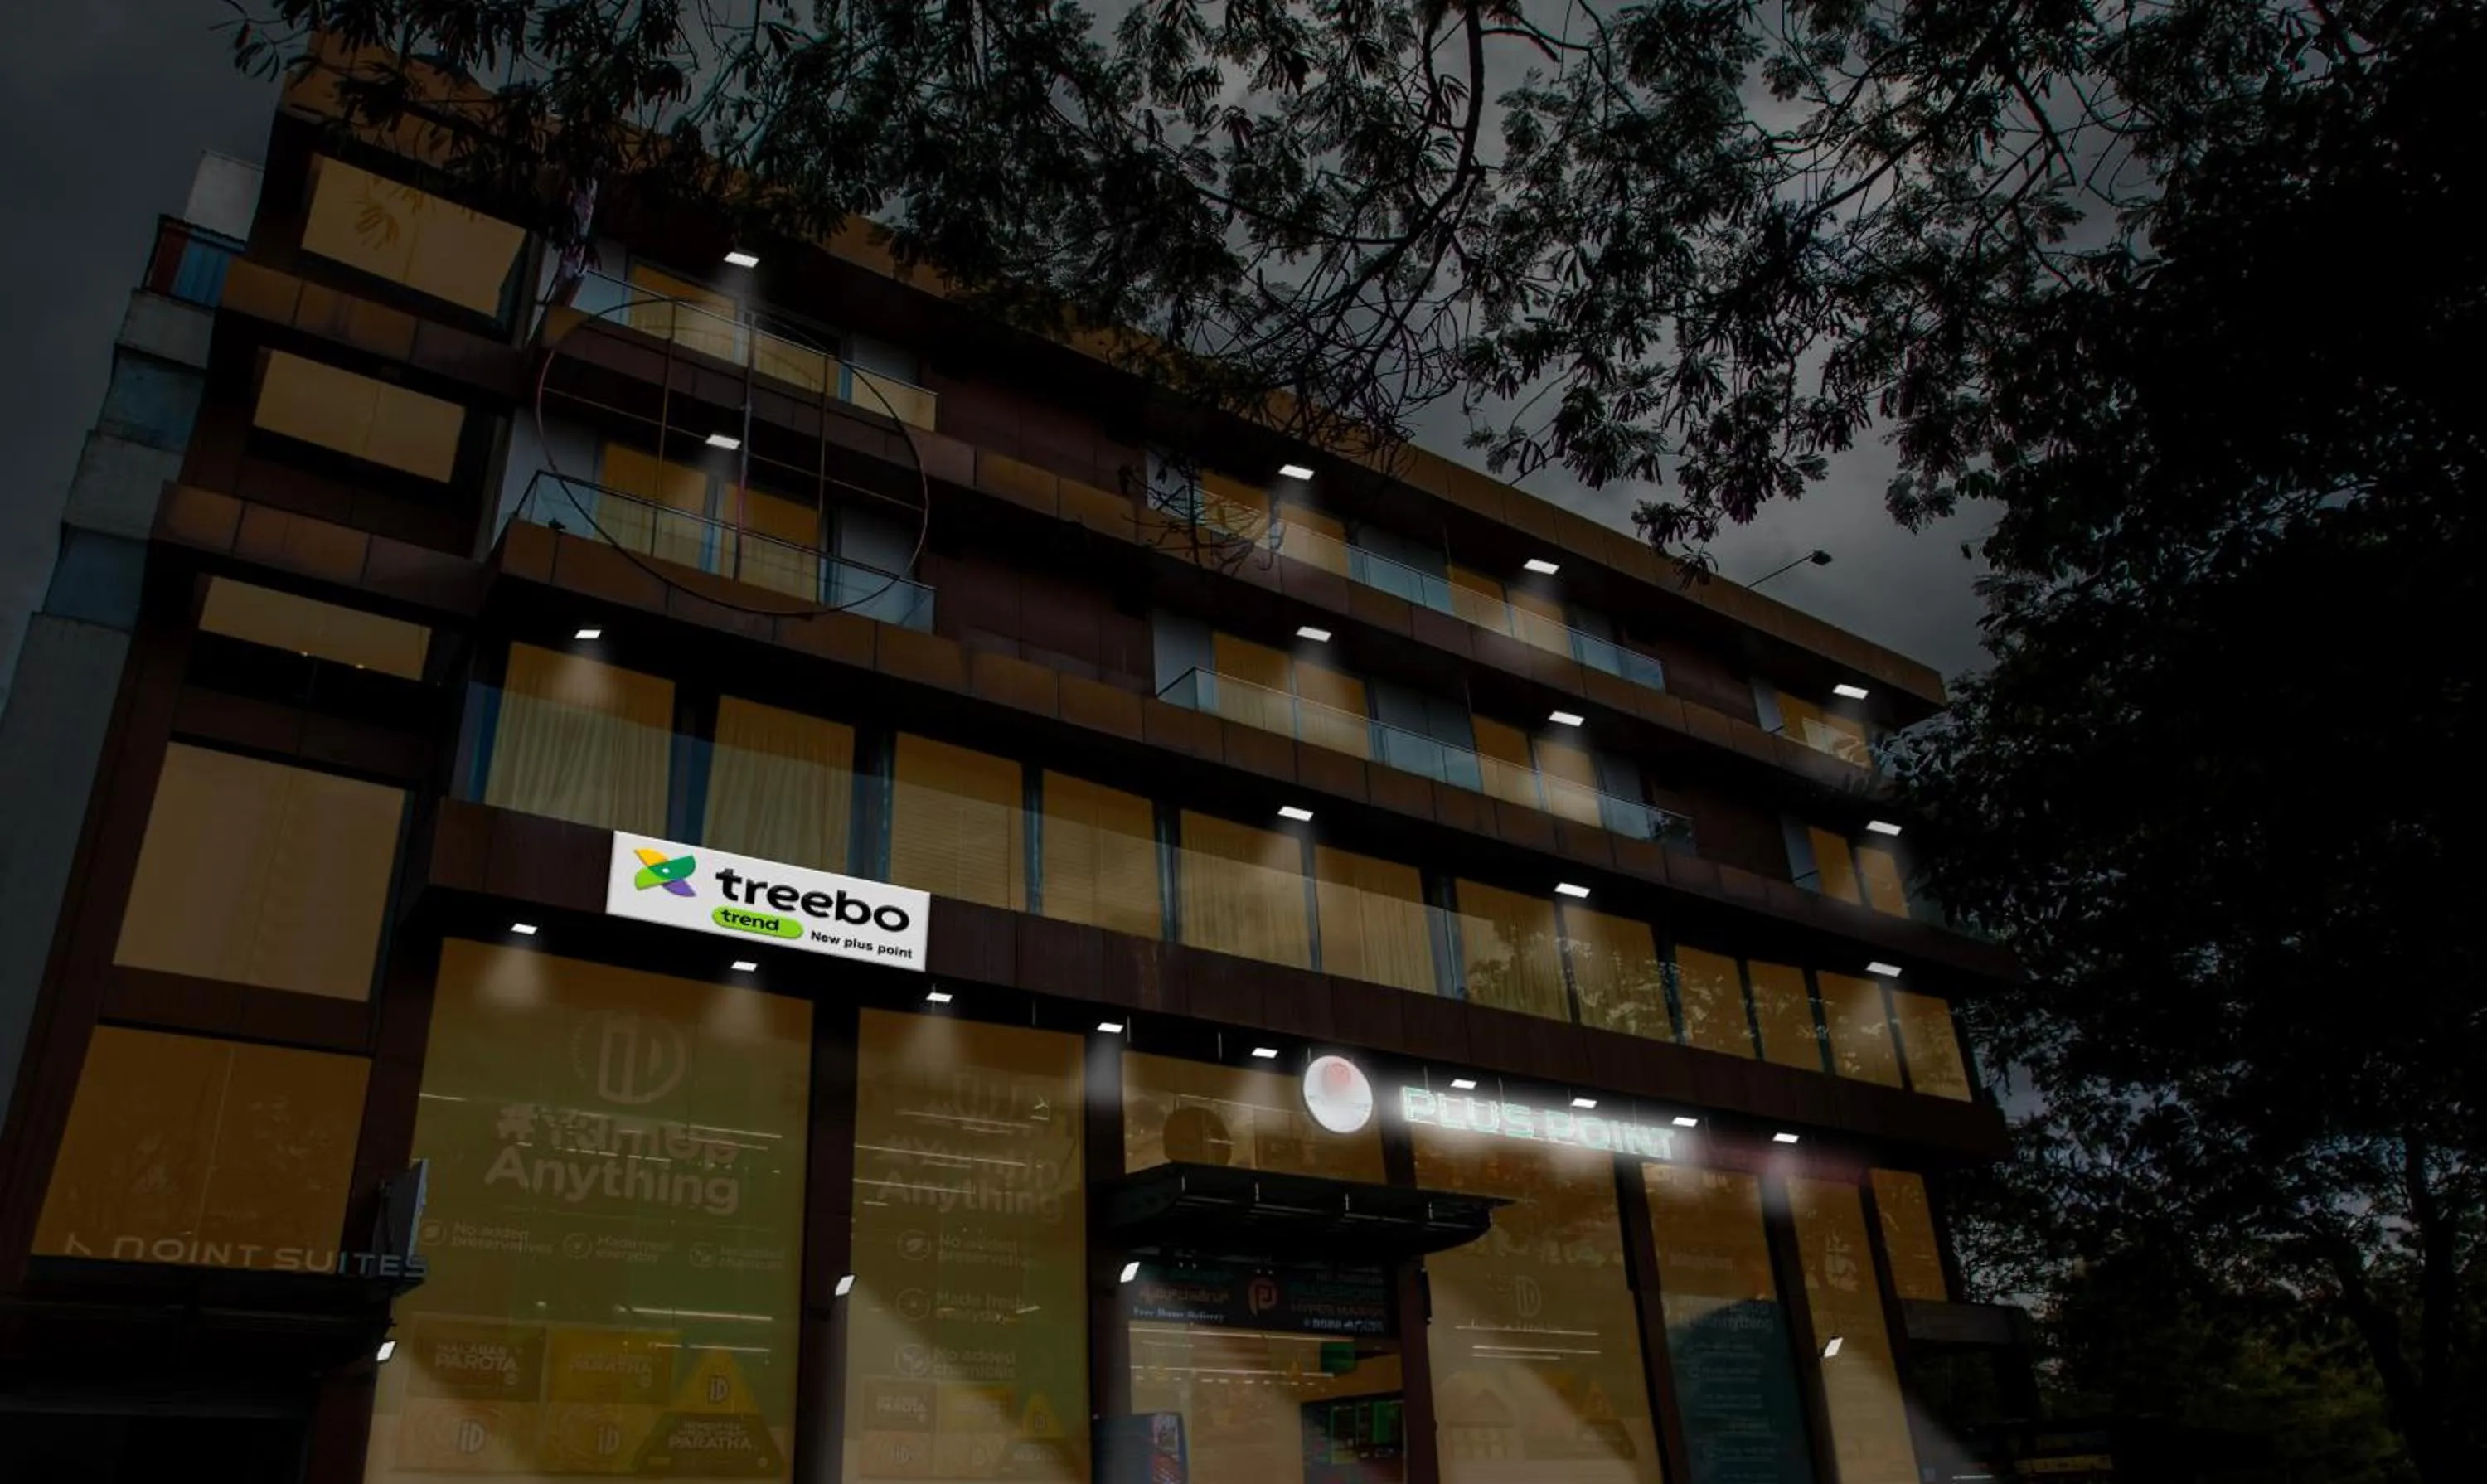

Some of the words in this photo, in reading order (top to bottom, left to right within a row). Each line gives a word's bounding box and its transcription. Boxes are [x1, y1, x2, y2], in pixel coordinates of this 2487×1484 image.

[715, 868, 909, 932] treebo
[720, 909, 779, 931] trend
[811, 929, 839, 944] New
[845, 937, 873, 953] plus
[877, 944, 914, 959] point
[1400, 1084, 1534, 1139] PLUS
[1542, 1108, 1675, 1160] POINT
[482, 1145, 740, 1216] Anything
[274, 1246, 428, 1280] SUITES
[435, 1352, 519, 1373] PAROTA
